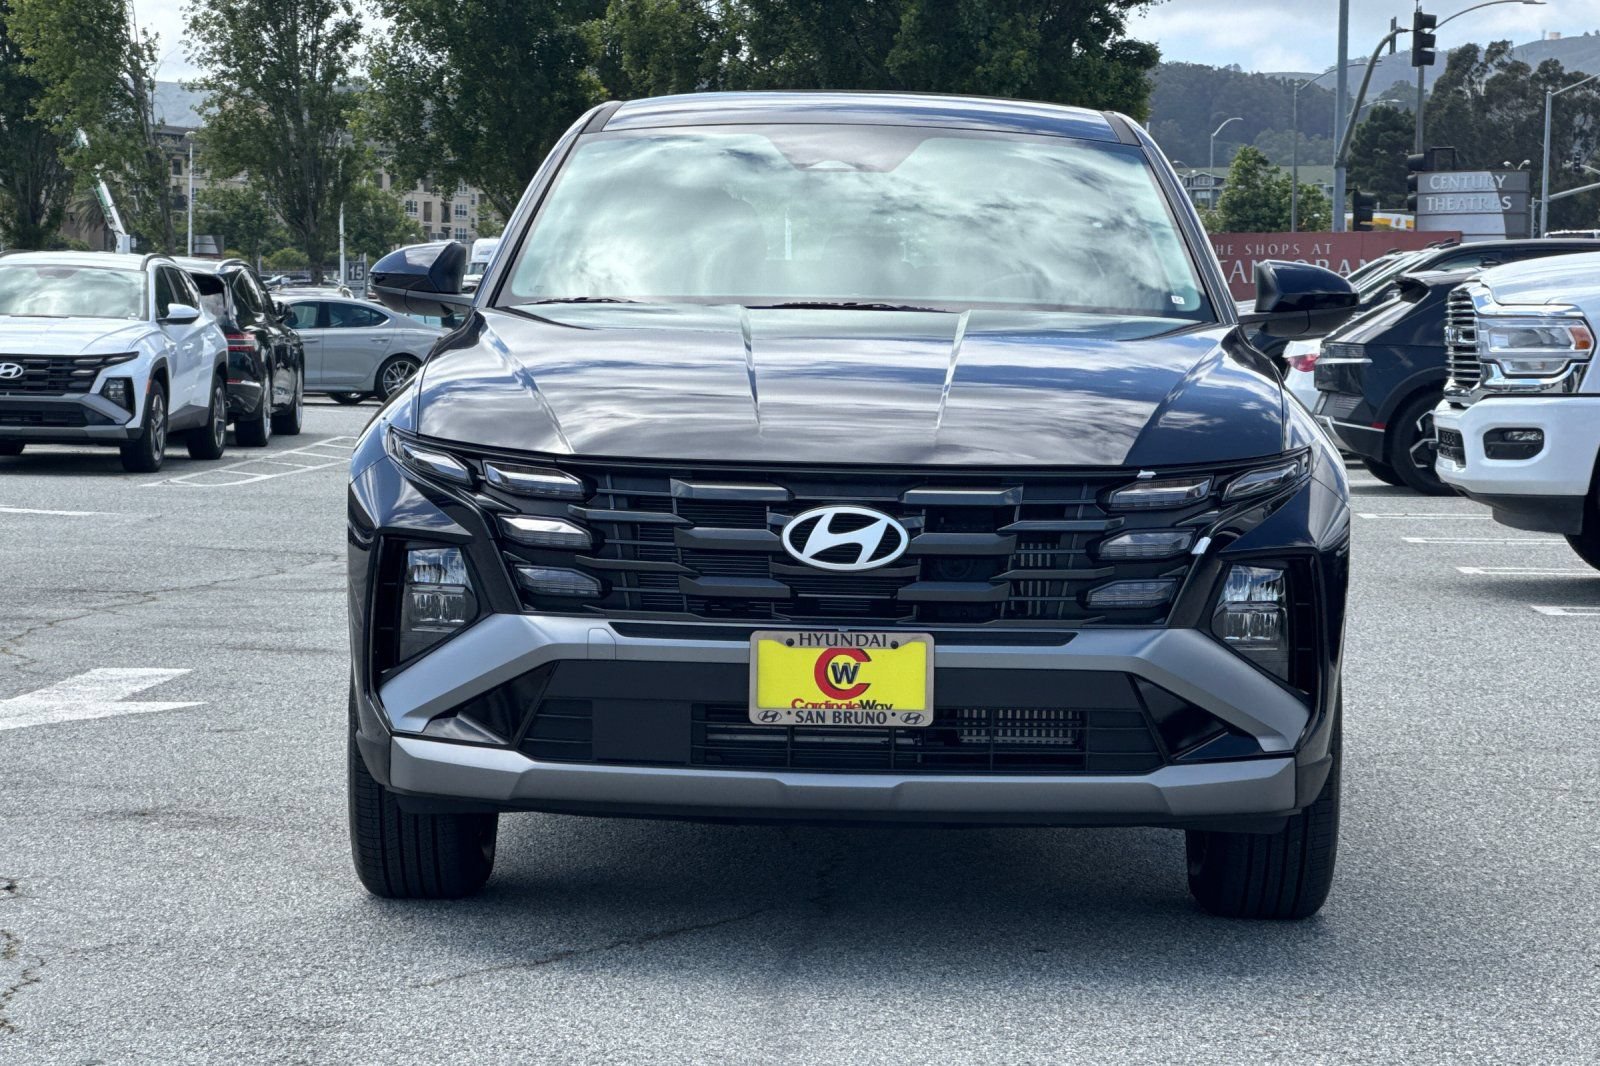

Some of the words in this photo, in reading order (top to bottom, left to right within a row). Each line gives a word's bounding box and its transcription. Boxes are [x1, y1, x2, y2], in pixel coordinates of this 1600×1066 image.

[1429, 174, 1507, 190] CENTURY
[1425, 196, 1513, 211] THEATRES
[1214, 244, 1234, 256] HE
[1244, 243, 1300, 256] SHOPS
[1311, 243, 1332, 255] AT
[350, 266, 363, 280] 15
[798, 632, 887, 648] HYUNDAI
[795, 710, 826, 724] SAN
[832, 711, 888, 725] BRUNO
